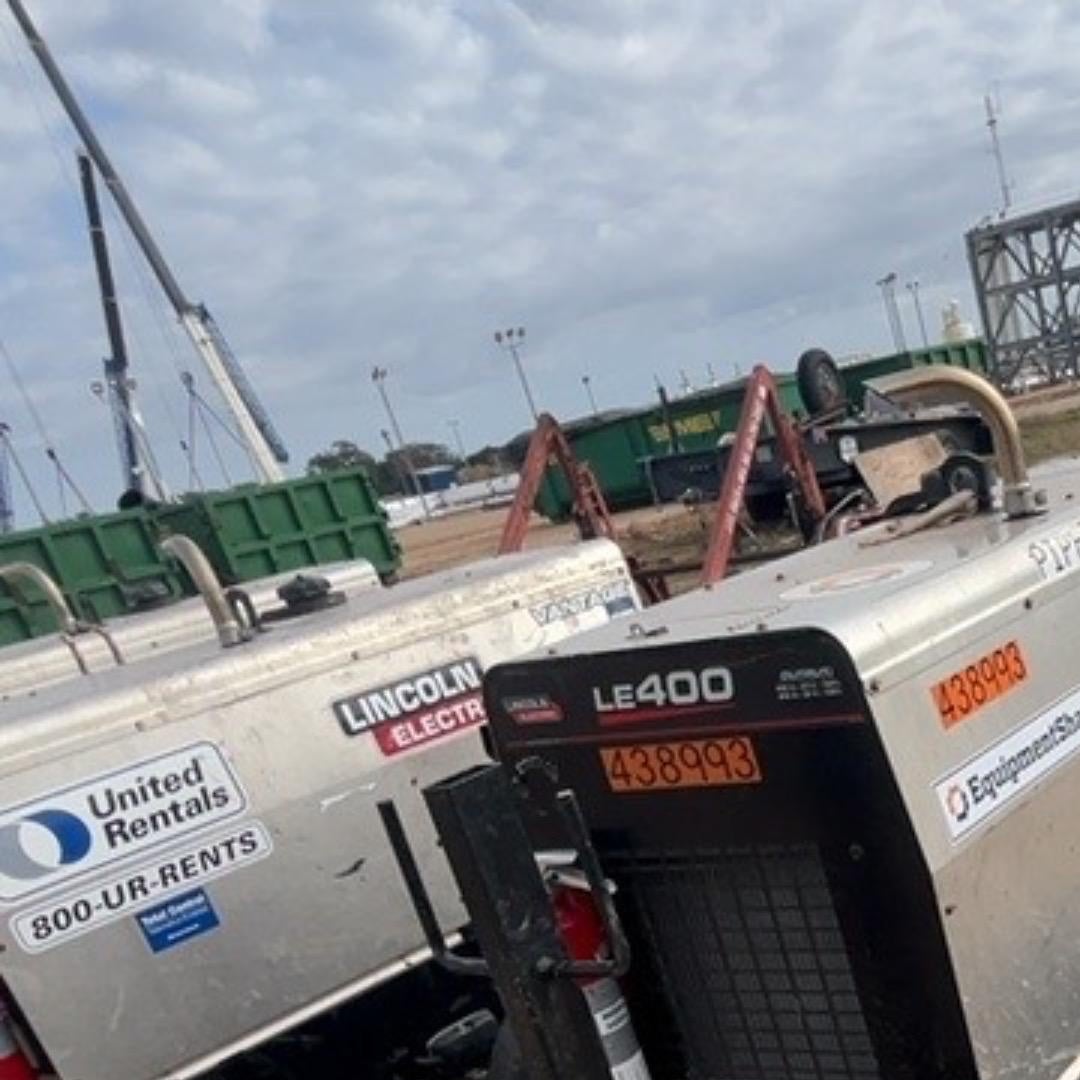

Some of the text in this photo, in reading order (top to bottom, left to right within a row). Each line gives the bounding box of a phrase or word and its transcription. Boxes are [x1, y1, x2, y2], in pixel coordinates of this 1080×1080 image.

[341, 661, 481, 731] LINCOLN
[593, 666, 735, 712] LE400
[939, 640, 1027, 721] 438993
[389, 698, 486, 748] ELECTR
[87, 757, 205, 820] United
[611, 738, 756, 787] 438993
[104, 785, 230, 849] Rentals
[31, 830, 259, 941] 800-UR-RENTS
